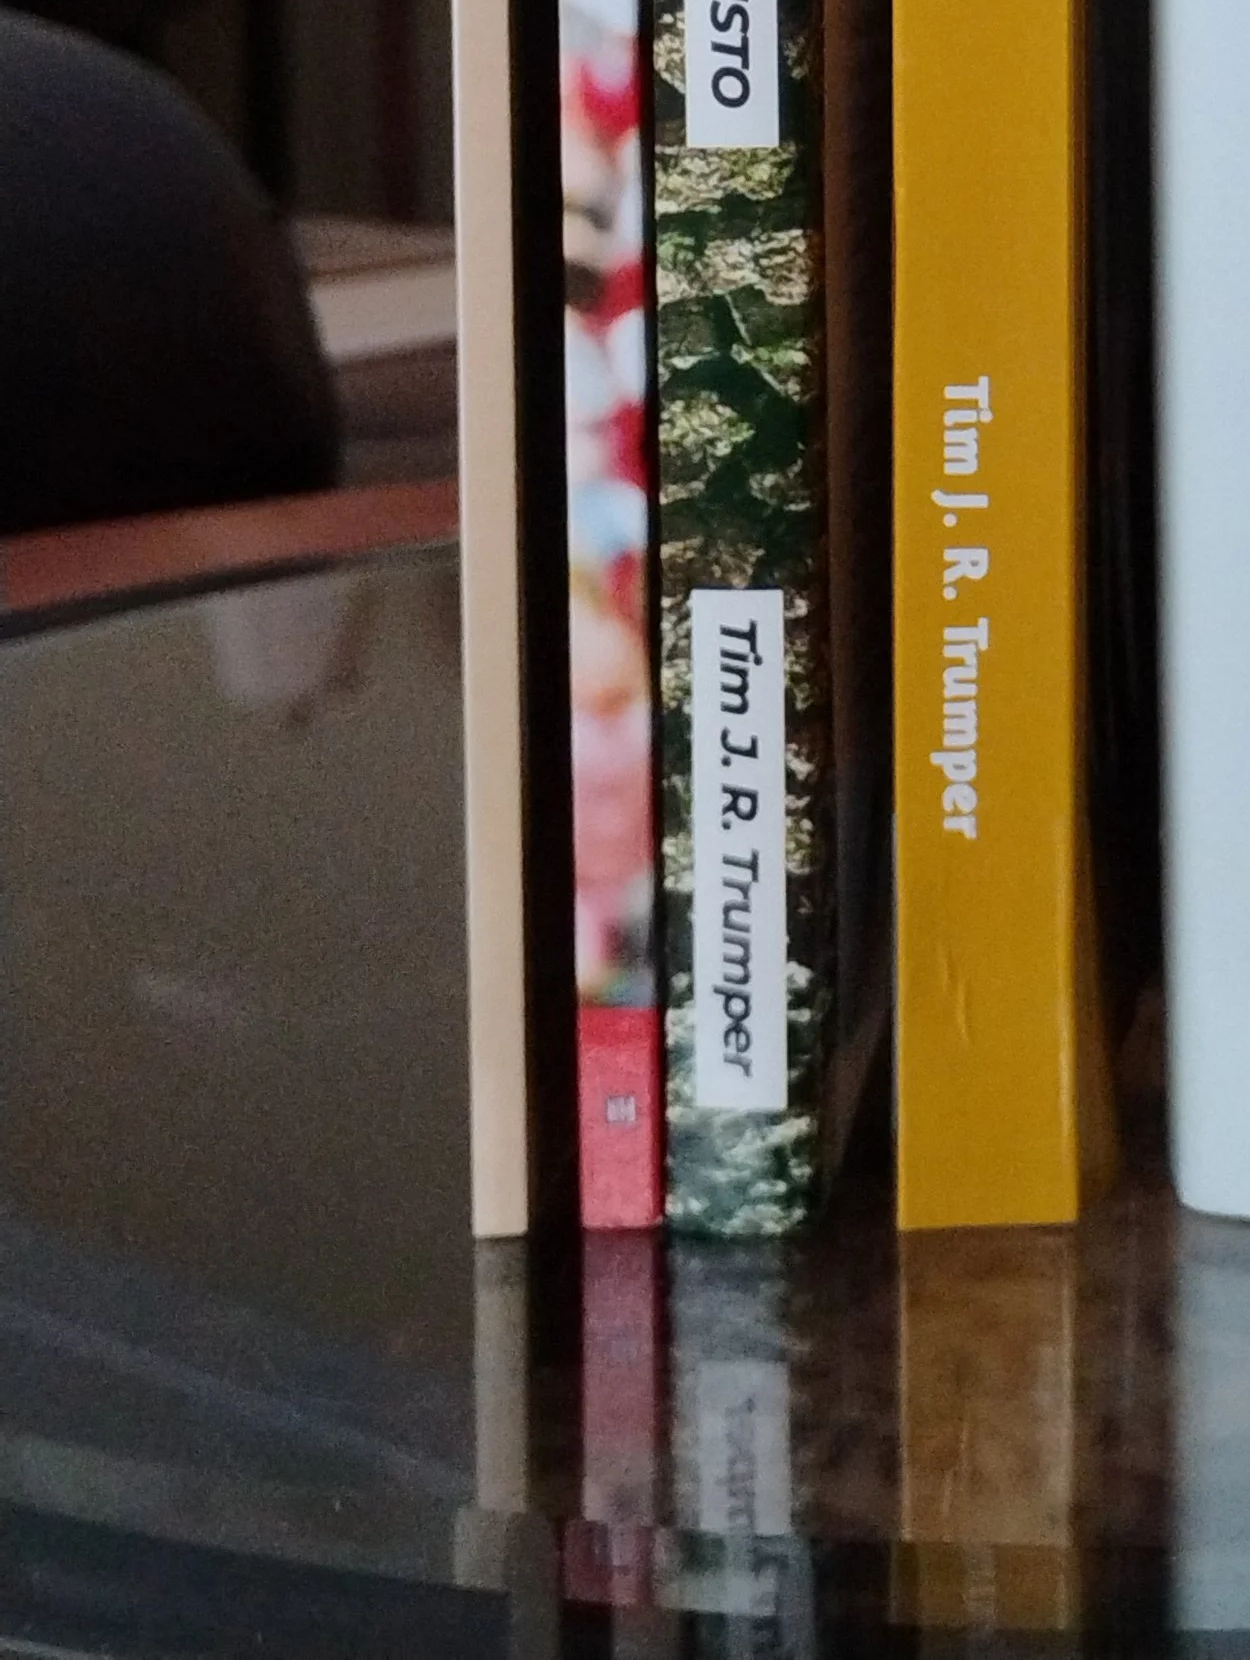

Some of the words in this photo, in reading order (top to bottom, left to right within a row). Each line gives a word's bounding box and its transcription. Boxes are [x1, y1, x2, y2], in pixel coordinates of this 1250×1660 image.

[942, 375, 994, 477] Tim
[930, 489, 989, 528] J.
[942, 547, 990, 601] R.
[719, 620, 762, 716] Tim
[719, 727, 759, 768] J.
[929, 616, 989, 840] Trumper
[720, 783, 759, 832] R.
[712, 848, 759, 1078] Trumper
